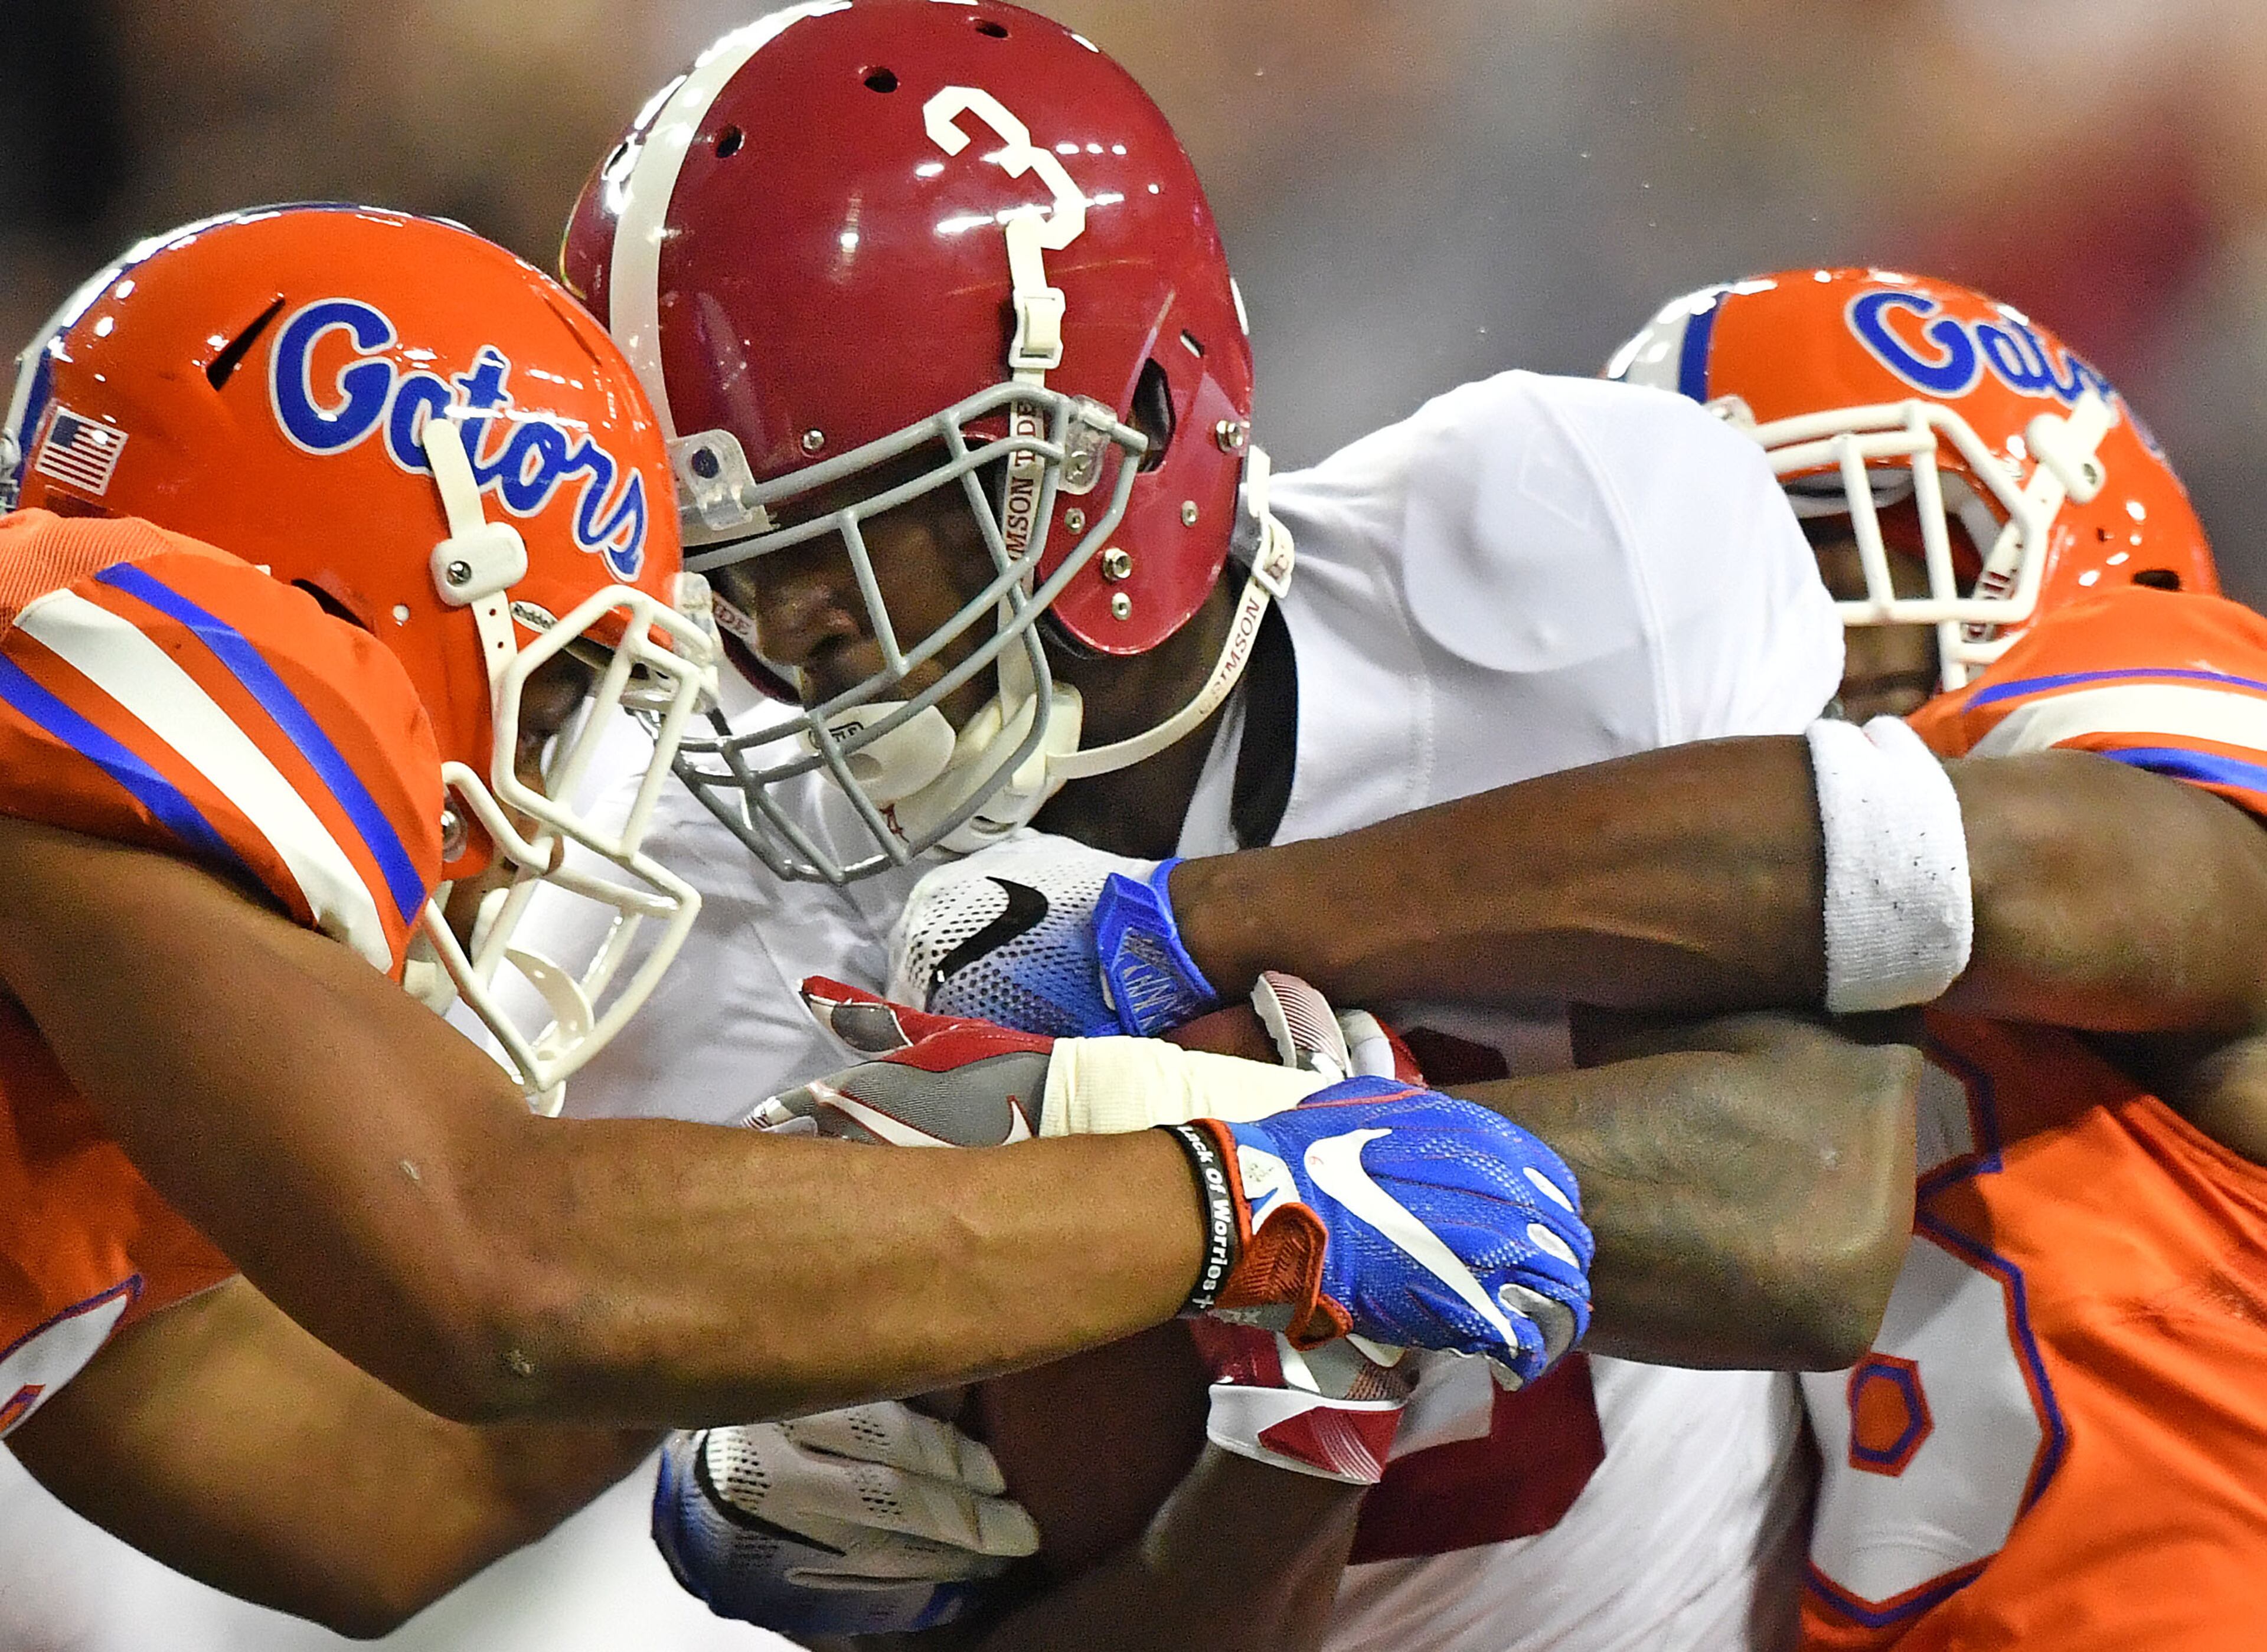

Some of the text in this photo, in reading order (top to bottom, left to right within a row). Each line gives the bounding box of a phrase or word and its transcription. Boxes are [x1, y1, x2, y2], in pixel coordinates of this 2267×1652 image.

[922, 86, 1087, 250] 3
[269, 297, 648, 583] Gators
[1014, 401, 1037, 467] TDE
[1177, 1124, 1231, 1291] Lack Of Worries
